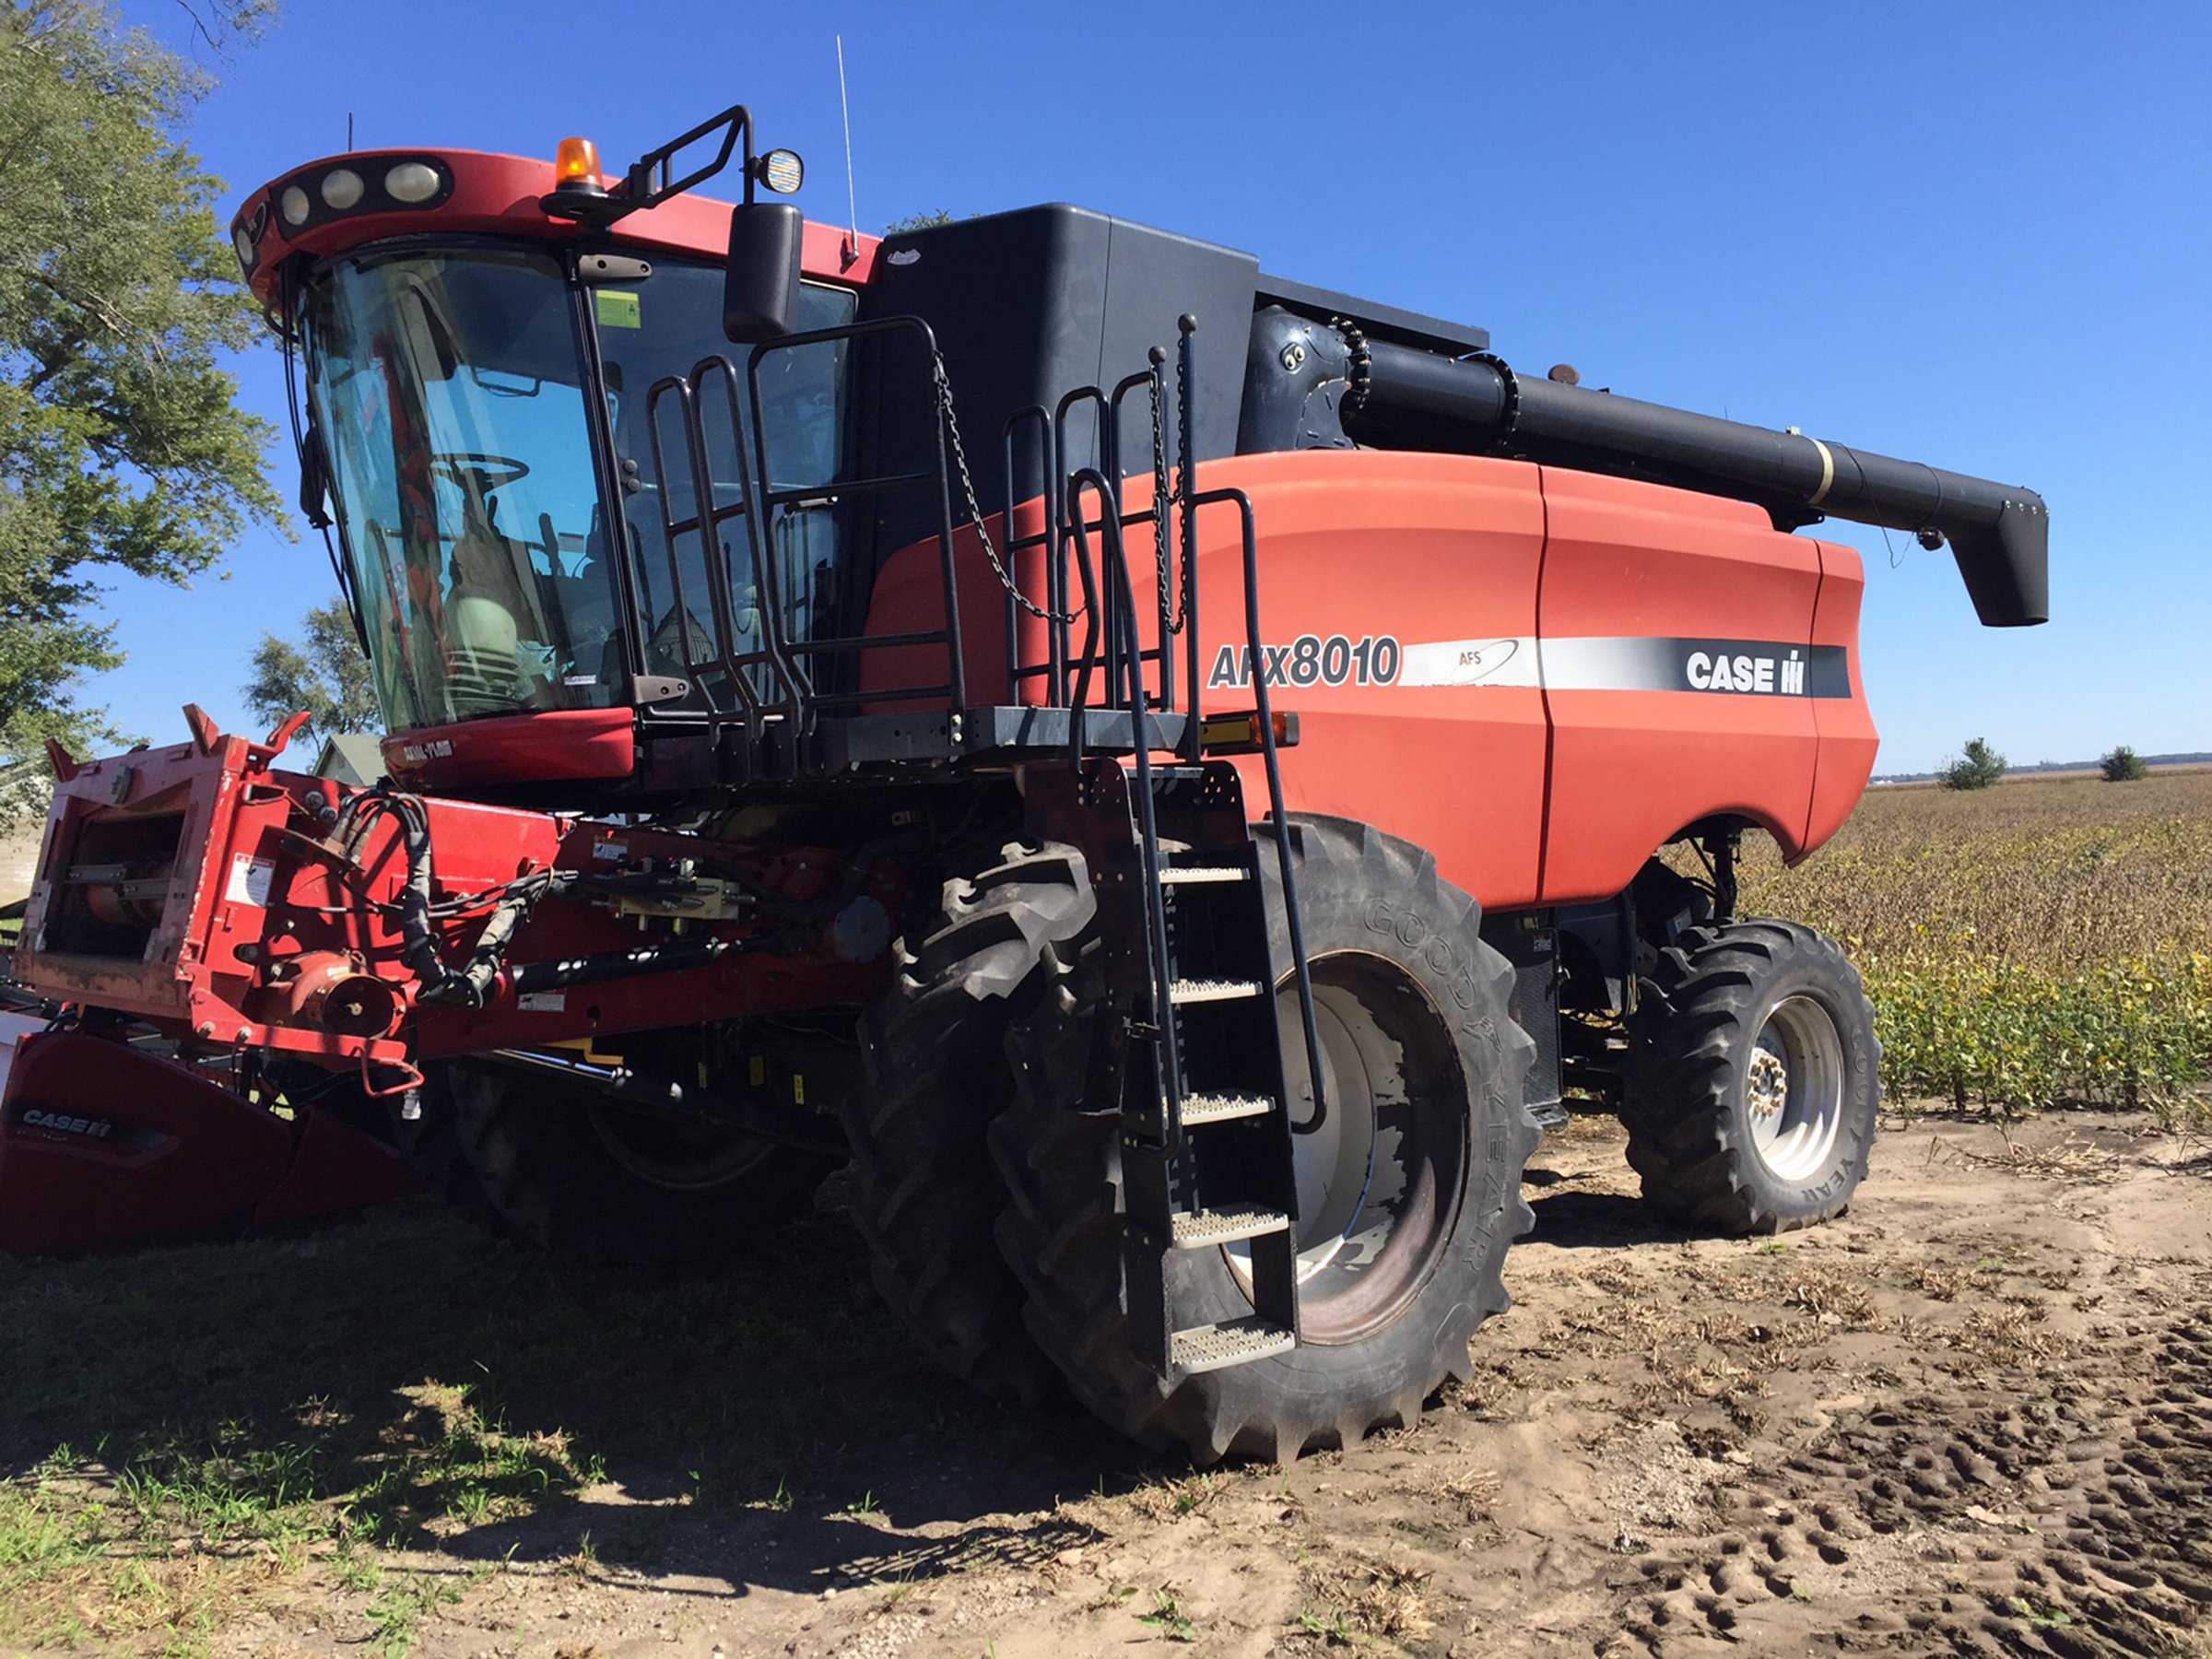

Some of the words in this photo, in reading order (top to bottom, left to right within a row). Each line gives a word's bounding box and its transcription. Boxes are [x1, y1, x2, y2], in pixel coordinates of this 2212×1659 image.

[1459, 651, 1482, 665] AFS
[1686, 651, 1775, 692] CASE
[23, 1110, 89, 1133] CASE
